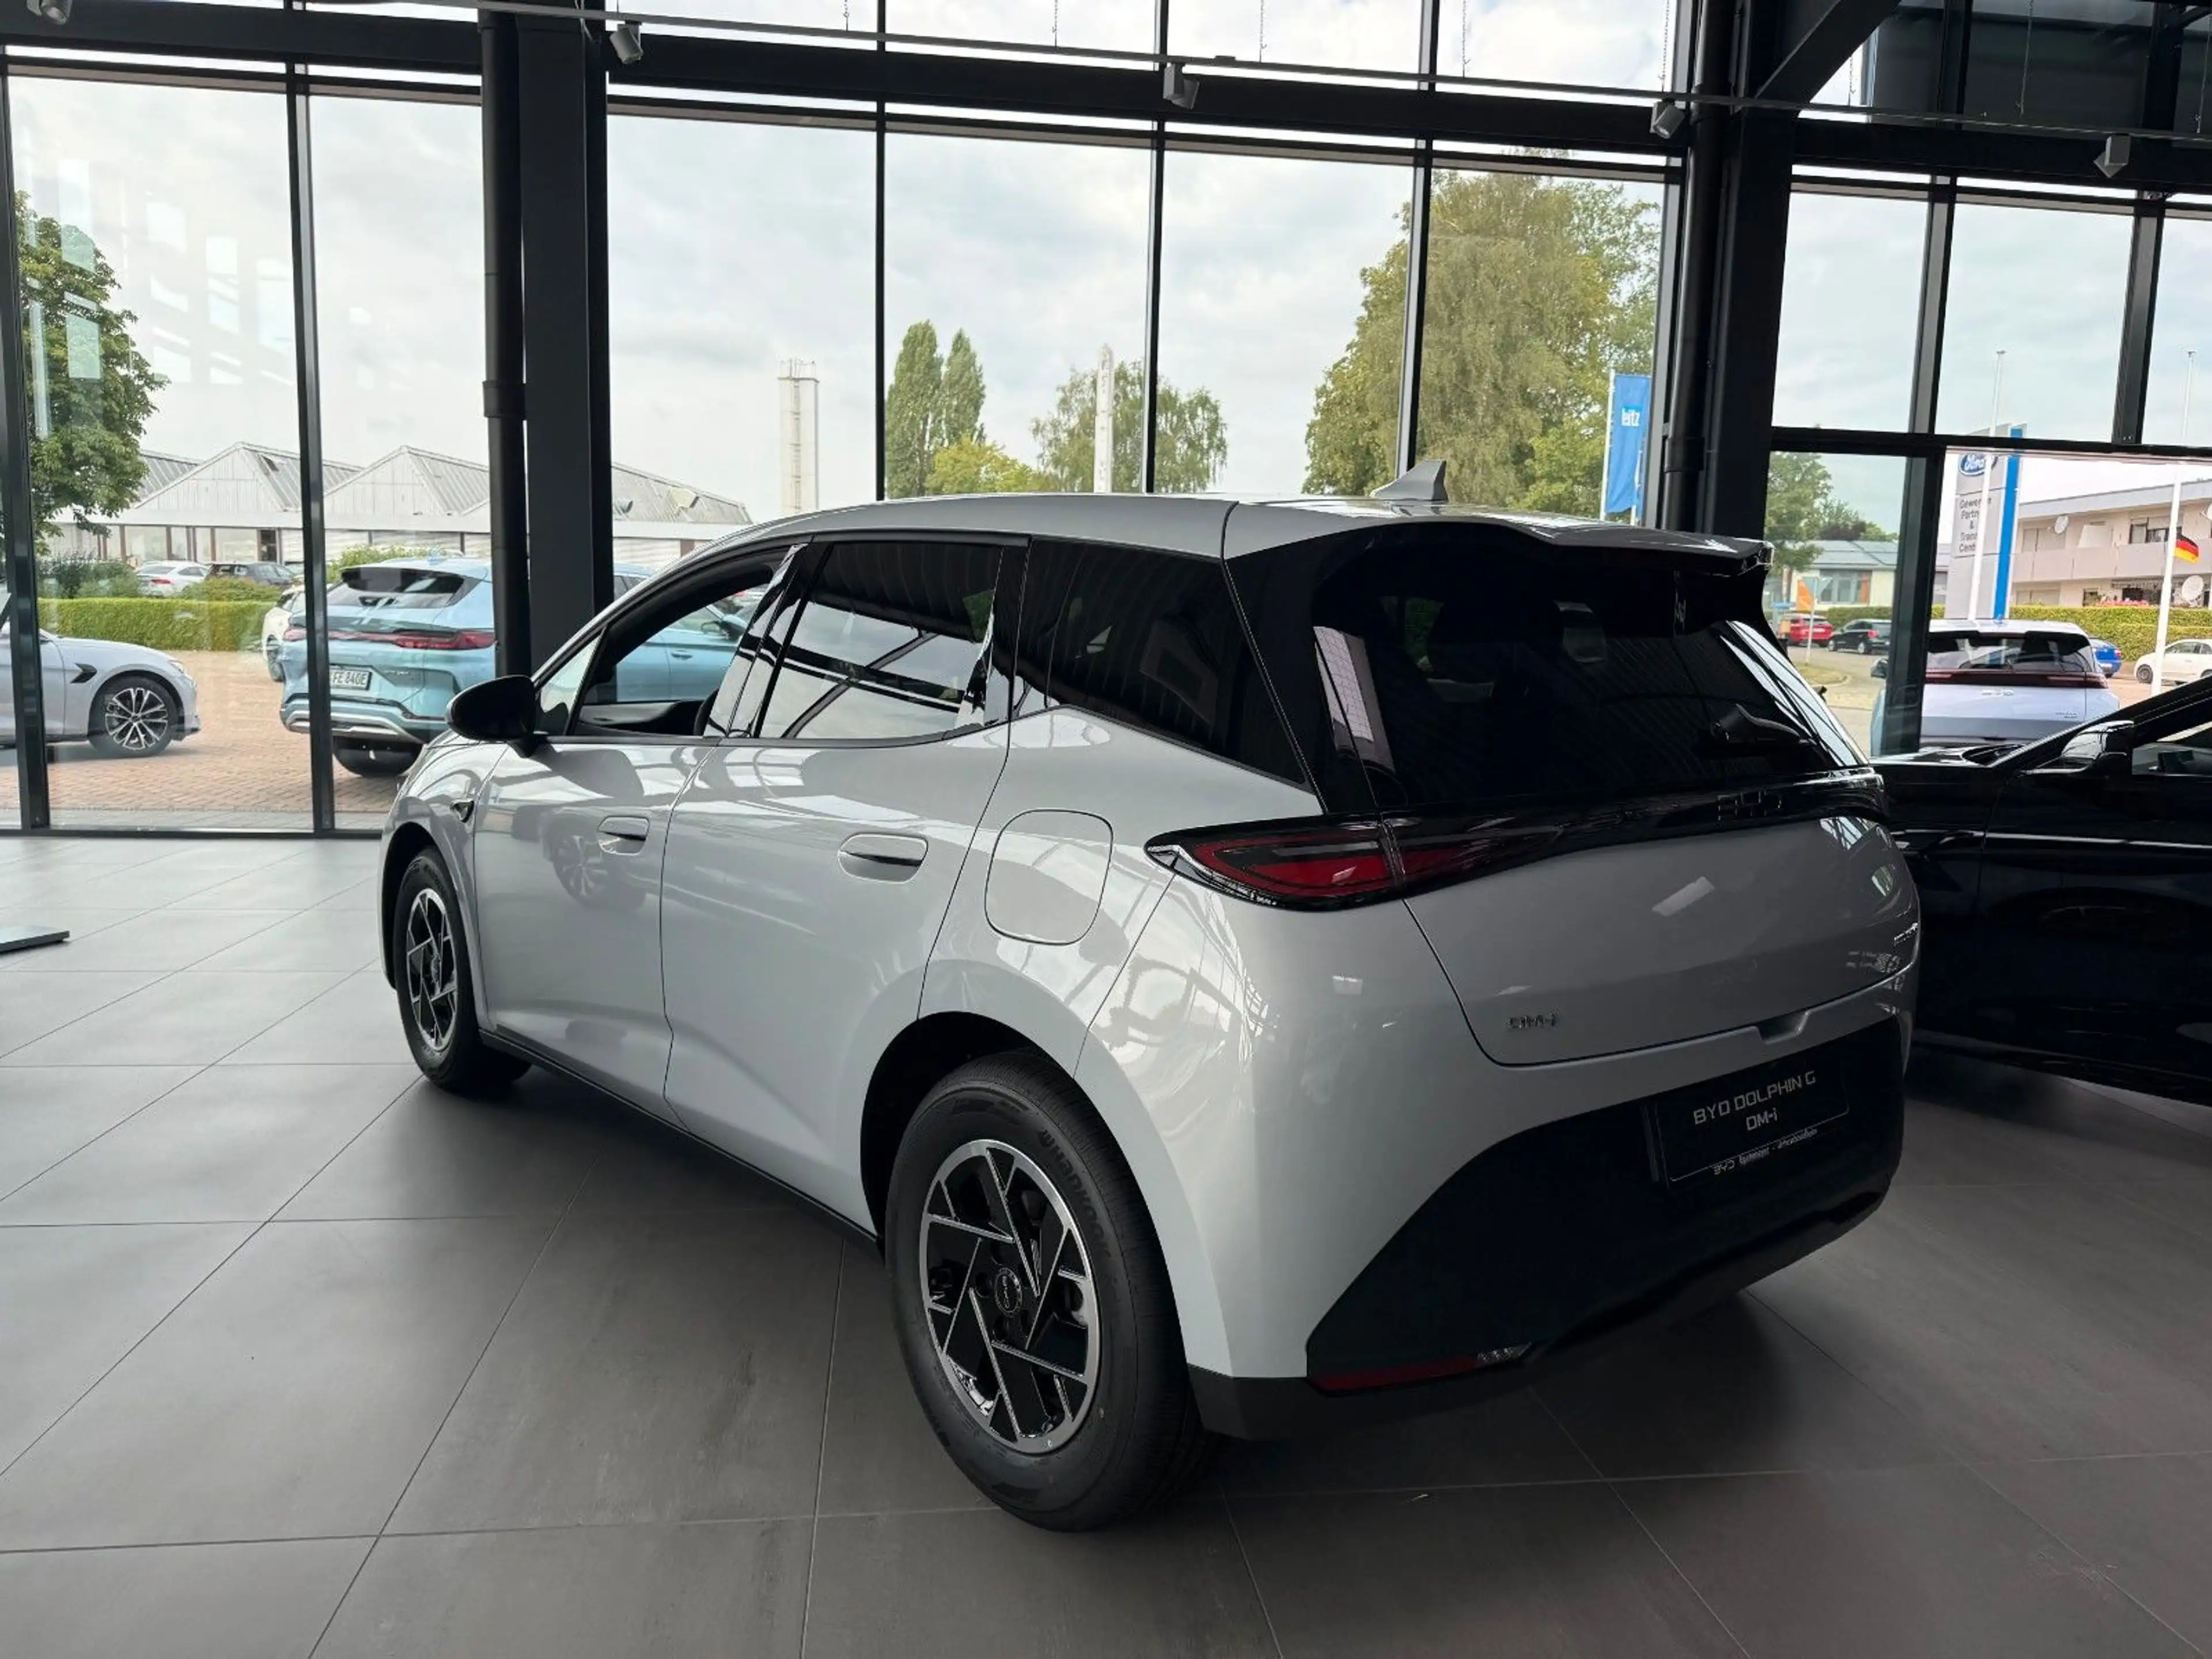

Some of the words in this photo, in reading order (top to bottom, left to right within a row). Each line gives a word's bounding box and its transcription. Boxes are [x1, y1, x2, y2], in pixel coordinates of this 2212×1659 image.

[1693, 1100, 1730, 1125] BYD
[1733, 1075, 1802, 1111] DOLPHIN
[1805, 1070, 1816, 1085] G
[1745, 1107, 1778, 1131] DM-i
